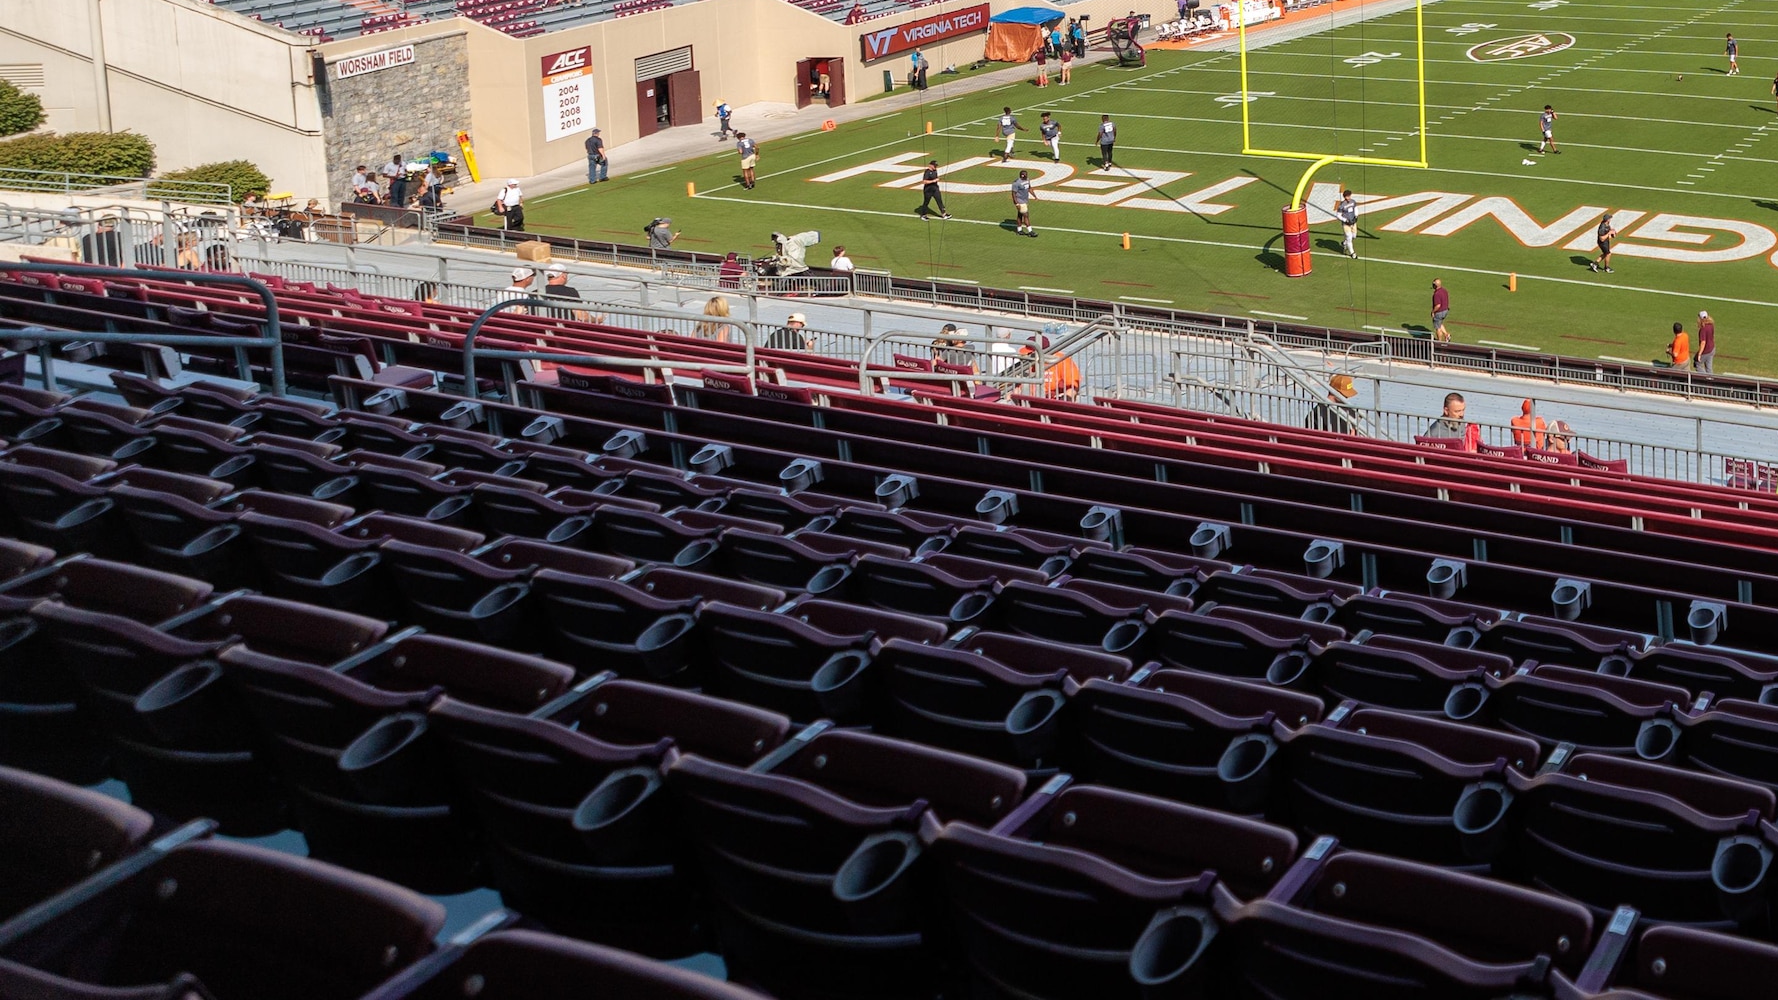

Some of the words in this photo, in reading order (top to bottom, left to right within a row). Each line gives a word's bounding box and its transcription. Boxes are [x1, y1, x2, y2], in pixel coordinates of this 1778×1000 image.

[867, 27, 899, 55] VT
[902, 19, 953, 42] VIRGINIA
[953, 11, 982, 29] TECH
[340, 53, 386, 76] WORSHAM
[388, 47, 413, 65] FIELD
[547, 48, 587, 75] ACC
[550, 69, 583, 84] CHAMPIONS
[559, 84, 579, 97] 2004
[559, 95, 580, 108] 2007
[560, 106, 581, 119] 2008
[561, 117, 581, 130] 2010
[805, 151, 1260, 216] TECH
[427, 335, 451, 348] GRAND
[897, 358, 918, 368] GRAND
[937, 365, 958, 375] GRAND
[561, 375, 589, 389] GRAND
[704, 377, 730, 390] GRAND
[615, 384, 646, 398] GRAND
[759, 388, 788, 400] GRAND
[1419, 441, 1446, 450] GRAND
[1531, 453, 1559, 464] GRAND
